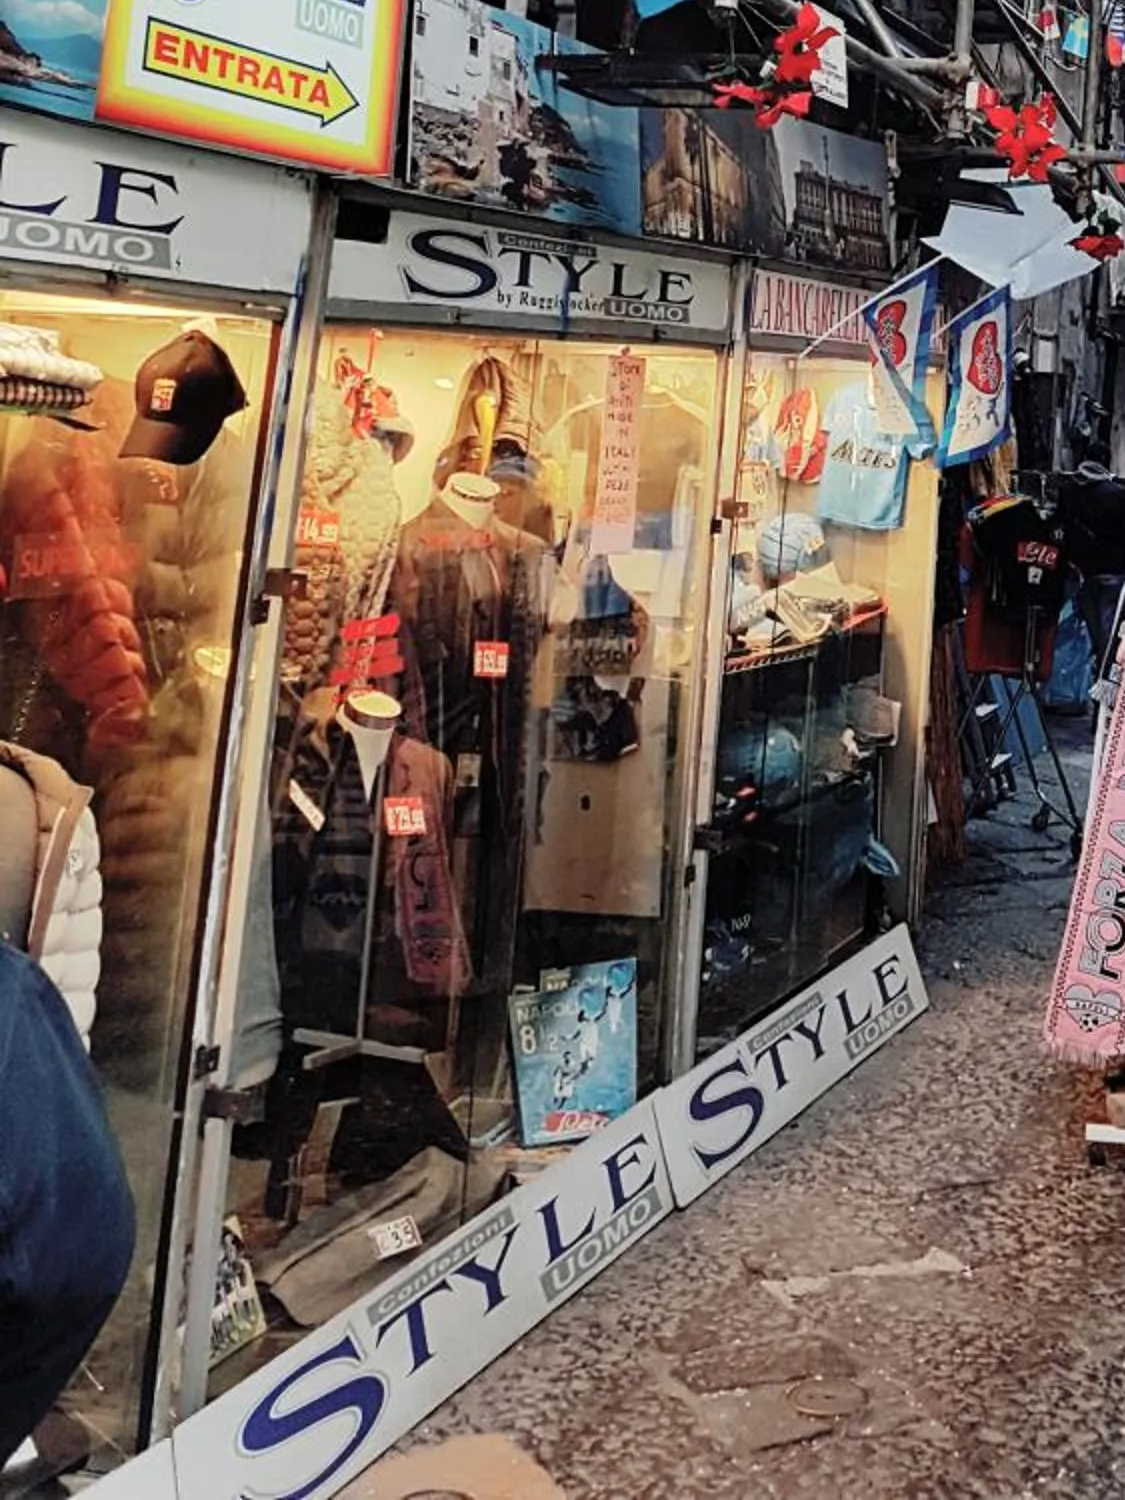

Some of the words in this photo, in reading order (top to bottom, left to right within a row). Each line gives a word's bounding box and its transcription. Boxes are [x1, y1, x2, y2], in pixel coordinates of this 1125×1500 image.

[302, 1, 361, 41] UOMO
[154, 31, 331, 108] ENTRATA
[404, 229, 695, 305] STYLE
[610, 302, 684, 322] UOMO
[690, 953, 908, 1170] STYLE
[850, 1001, 909, 1052] UOMO
[379, 1213, 511, 1317] Confezioni
[550, 1197, 652, 1290] UOMO
[236, 1133, 658, 1500] STYLE
